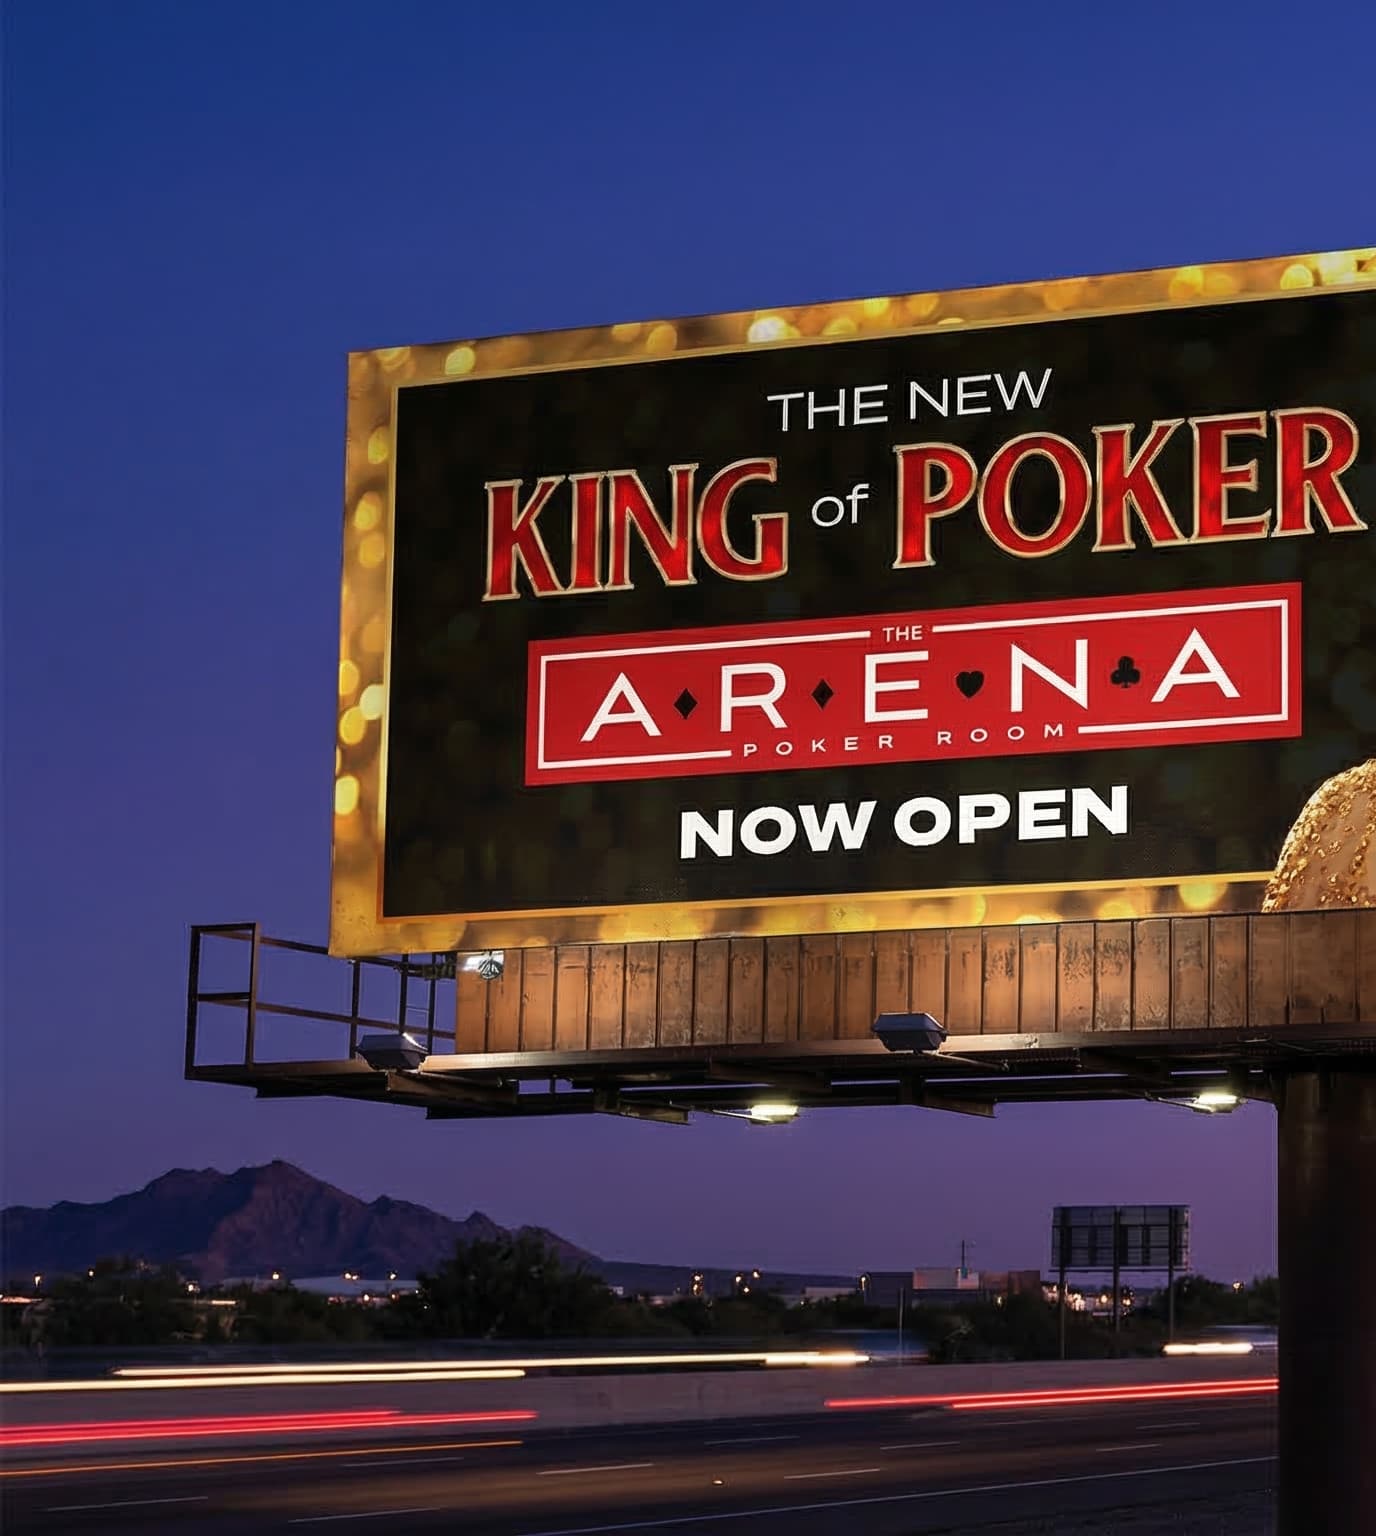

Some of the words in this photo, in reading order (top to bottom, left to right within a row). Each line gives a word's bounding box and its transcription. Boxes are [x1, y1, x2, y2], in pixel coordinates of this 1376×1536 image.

[766, 384, 889, 432] THE
[909, 367, 1053, 420] NEW
[482, 456, 790, 602] KING
[811, 483, 870, 527] of
[892, 406, 1369, 570] POKER
[882, 625, 923, 643] THE
[580, 626, 1241, 743] ARENA
[743, 734, 895, 758] POKER
[937, 723, 1064, 746] ROOM
[680, 800, 878, 860] NOW
[893, 785, 1129, 848] OPEN
